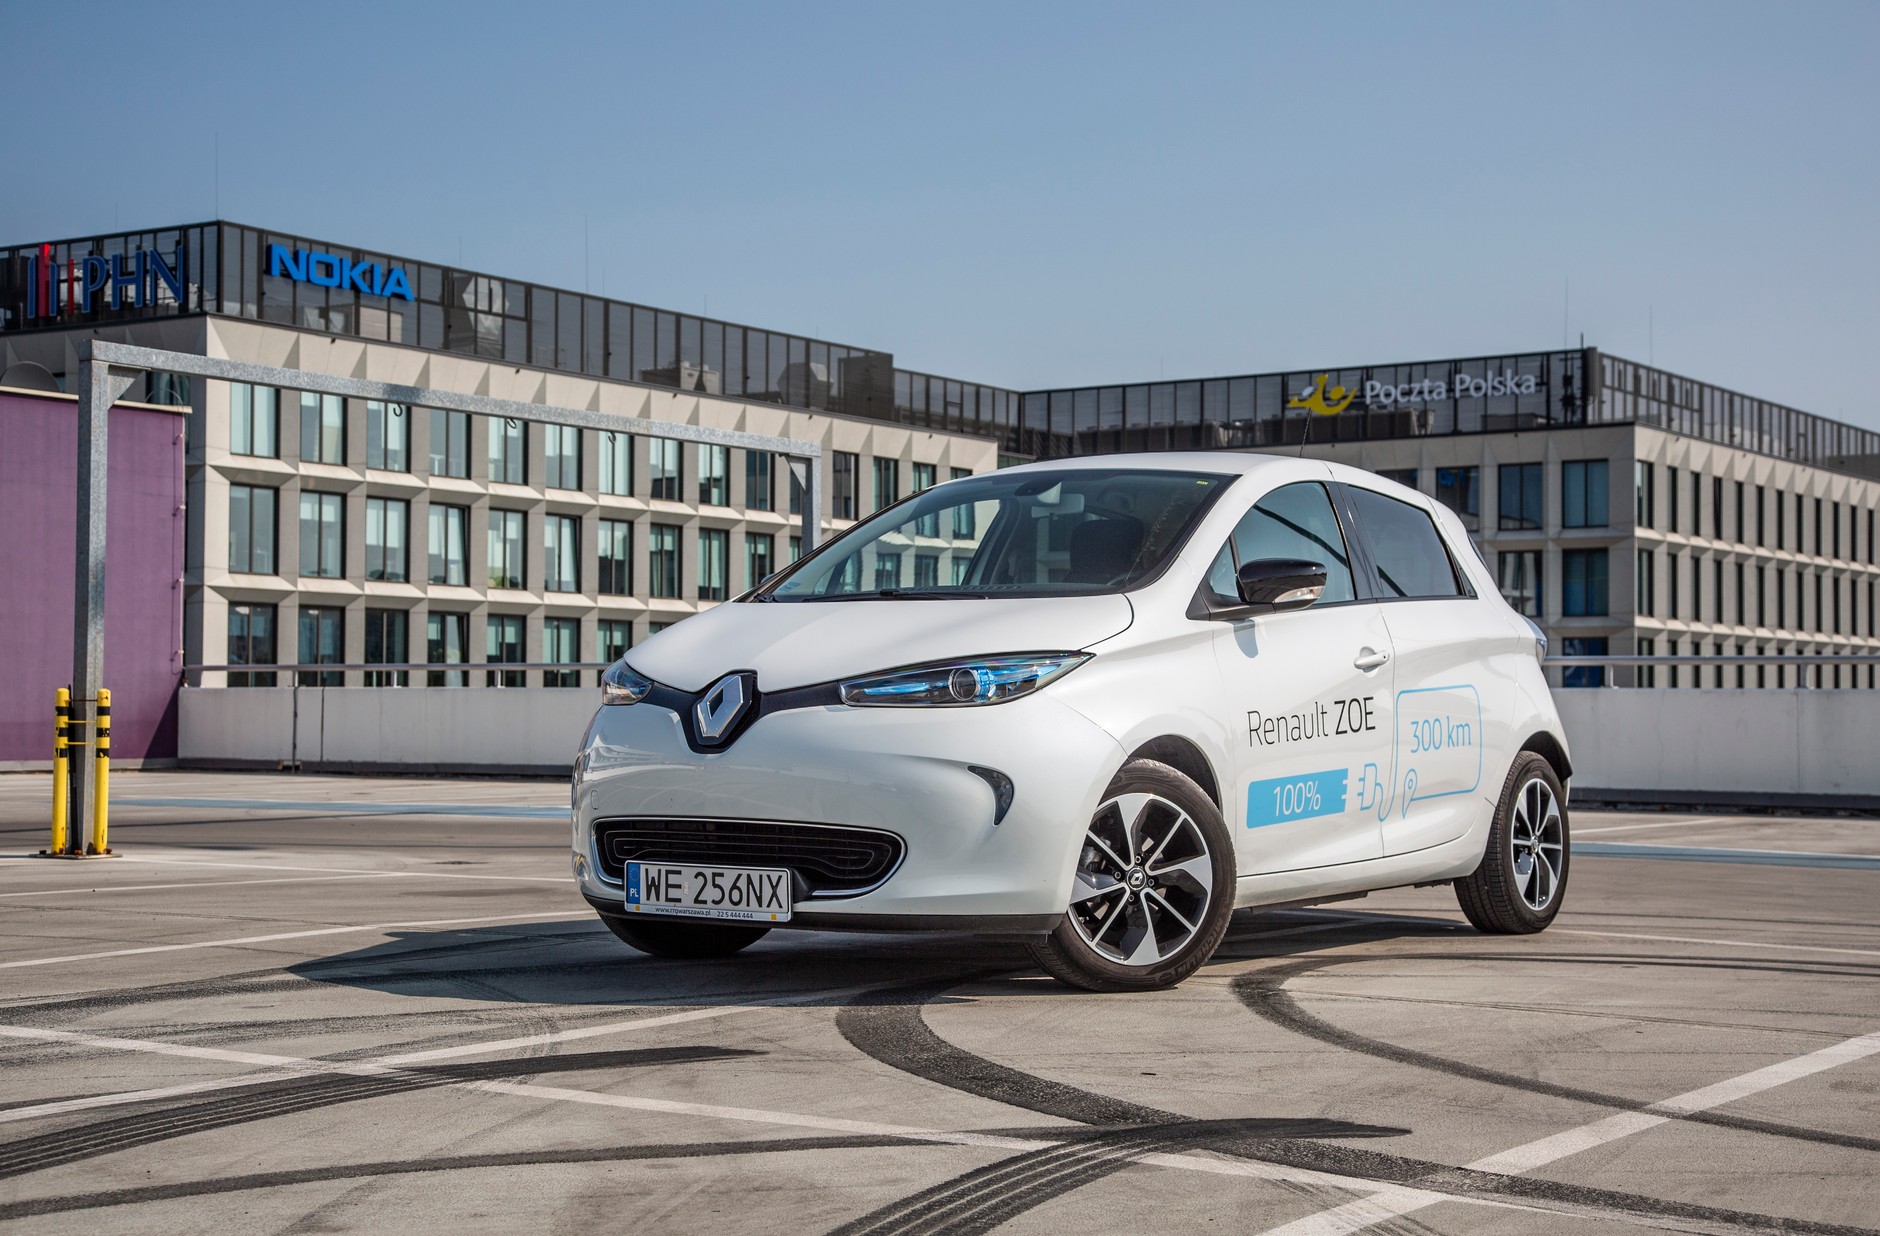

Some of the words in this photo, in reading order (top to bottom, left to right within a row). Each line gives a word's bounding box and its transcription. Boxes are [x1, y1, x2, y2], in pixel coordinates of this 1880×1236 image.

[82, 246, 184, 314] PHN
[269, 243, 415, 301] NOKIA
[1365, 379, 1447, 405] Poczta
[1454, 369, 1537, 398] Polska
[1247, 701, 1329, 748] Renault
[1334, 696, 1376, 735] ZOE
[1410, 717, 1443, 754] 300
[1446, 715, 1472, 749] km
[1273, 780, 1321, 817] 100%
[629, 888, 639, 898] PL
[645, 868, 682, 903] WE
[693, 871, 783, 909] 256NX
